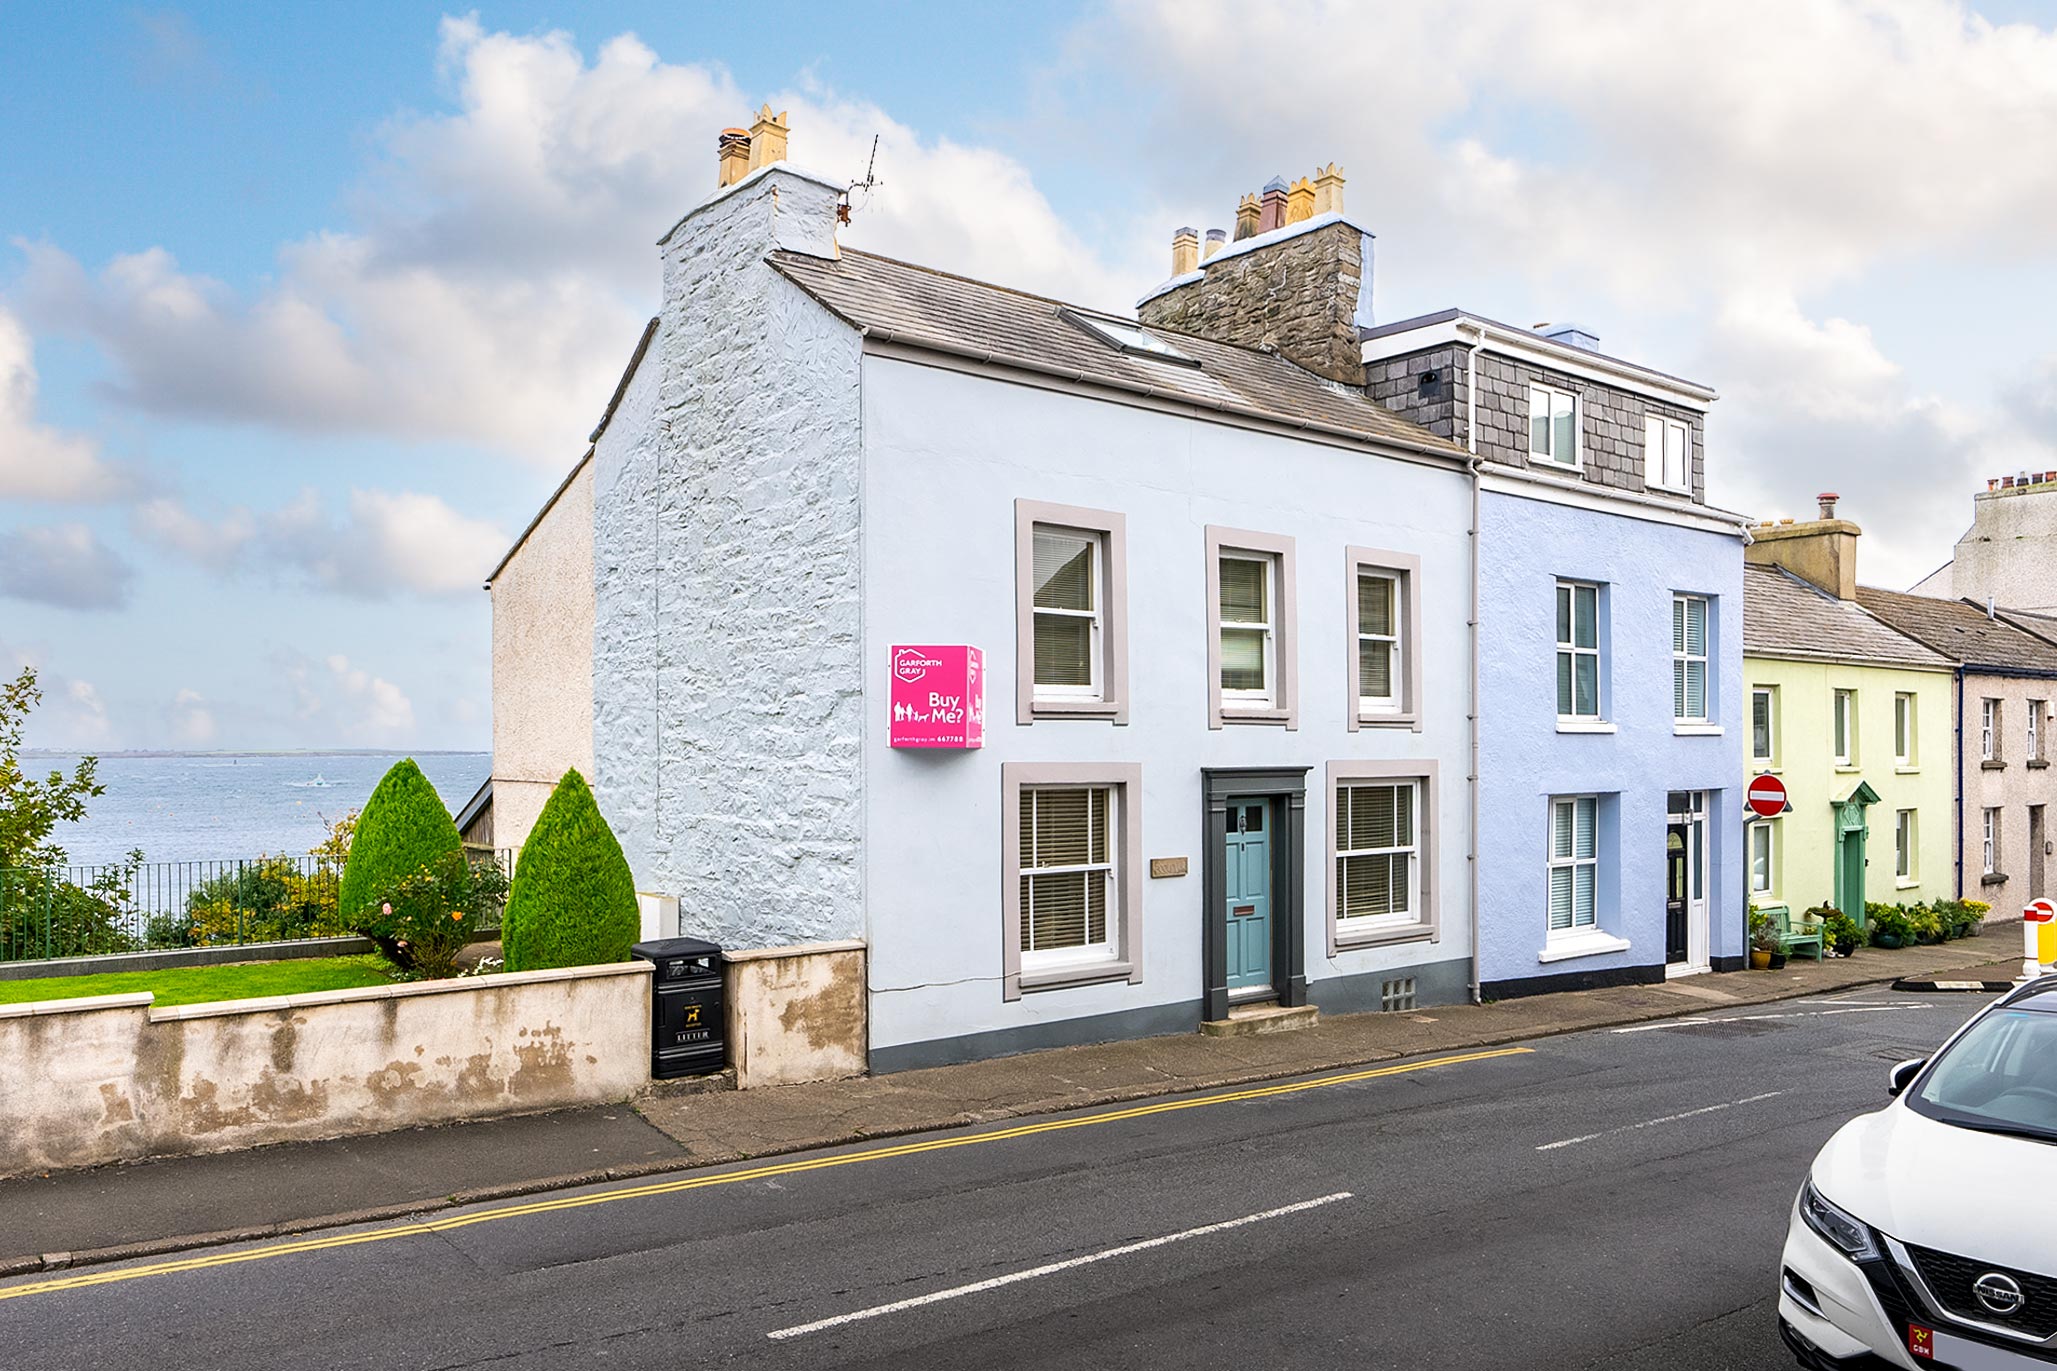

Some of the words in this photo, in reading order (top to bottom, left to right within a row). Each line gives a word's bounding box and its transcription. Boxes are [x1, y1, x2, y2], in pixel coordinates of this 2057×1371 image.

[899, 659, 942, 667] GARFORTH
[899, 667, 921, 675] GRAY
[928, 691, 960, 711] Buy
[931, 708, 964, 723] Me?
[937, 735, 964, 743] 667788
[677, 1031, 709, 1041] LITTER
[1977, 1285, 2019, 1303] NISSAN
